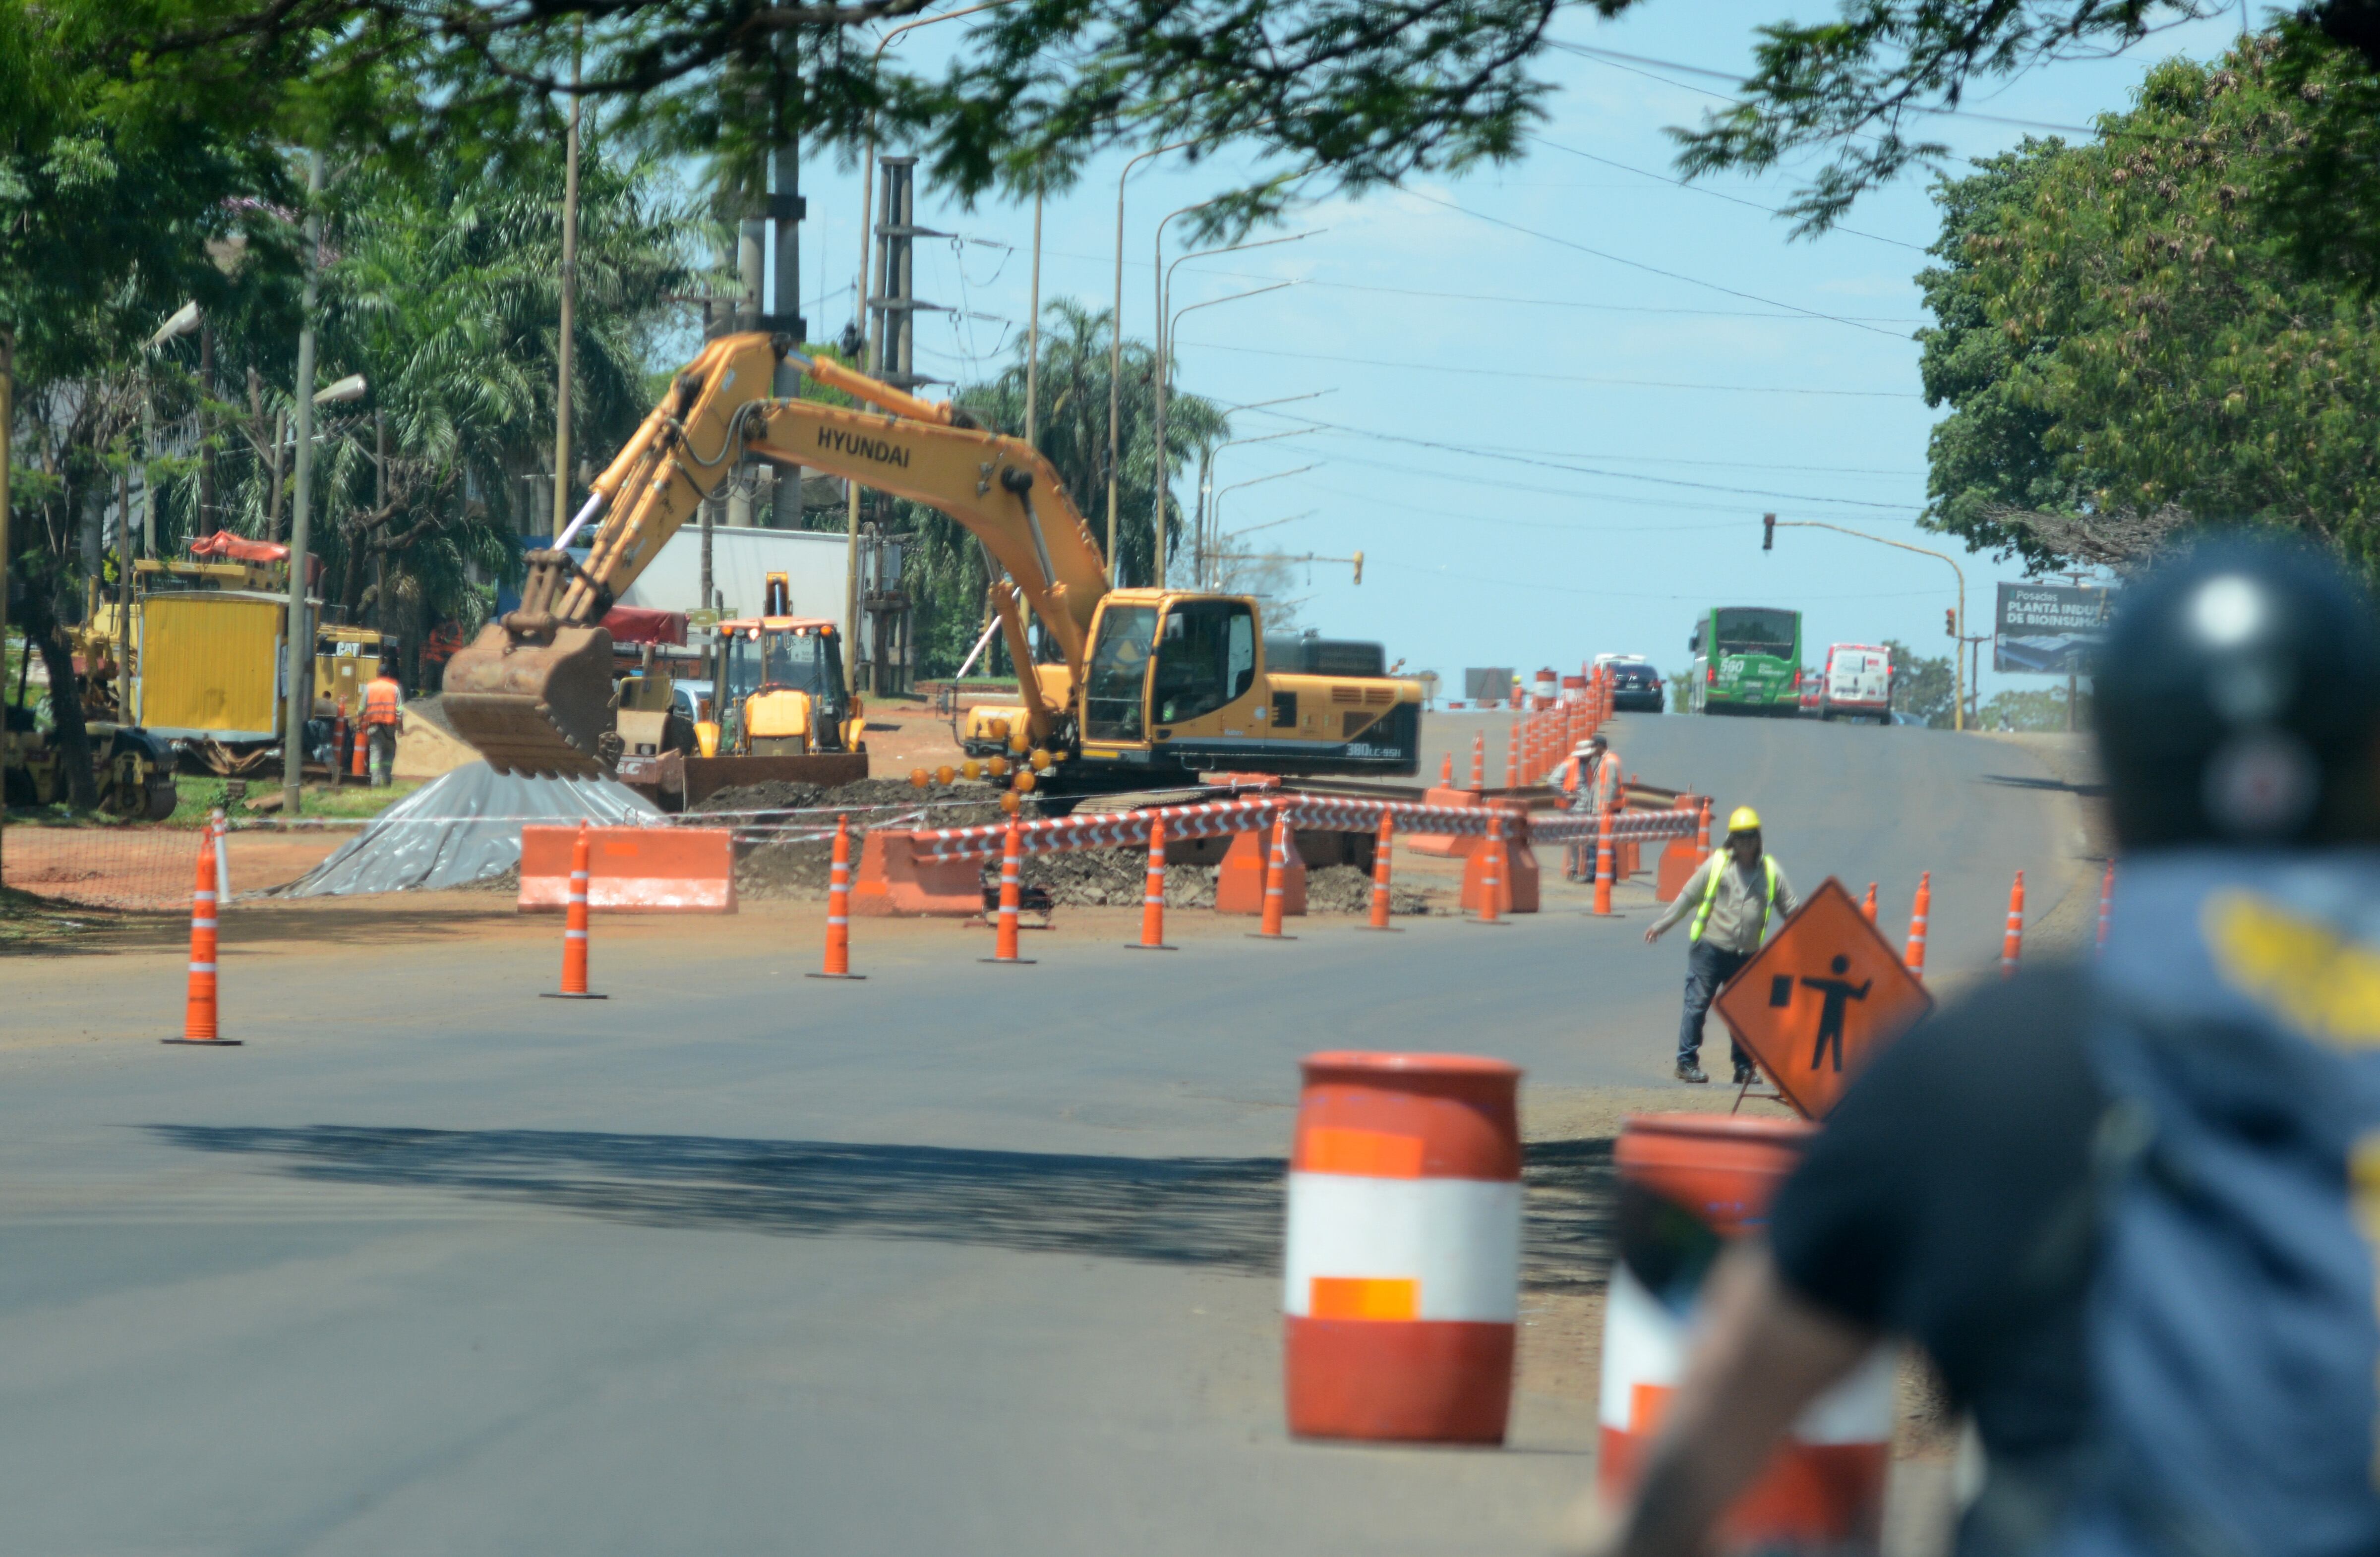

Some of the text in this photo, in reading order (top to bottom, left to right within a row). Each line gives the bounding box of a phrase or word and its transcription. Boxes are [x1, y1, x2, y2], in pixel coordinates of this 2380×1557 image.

[818, 426, 910, 467] HYUNDAI
[2016, 590, 2058, 602] Posadas
[2007, 601, 2060, 614] PLANTA
[2007, 612, 2024, 624] DE
[337, 641, 360, 658] CAT
